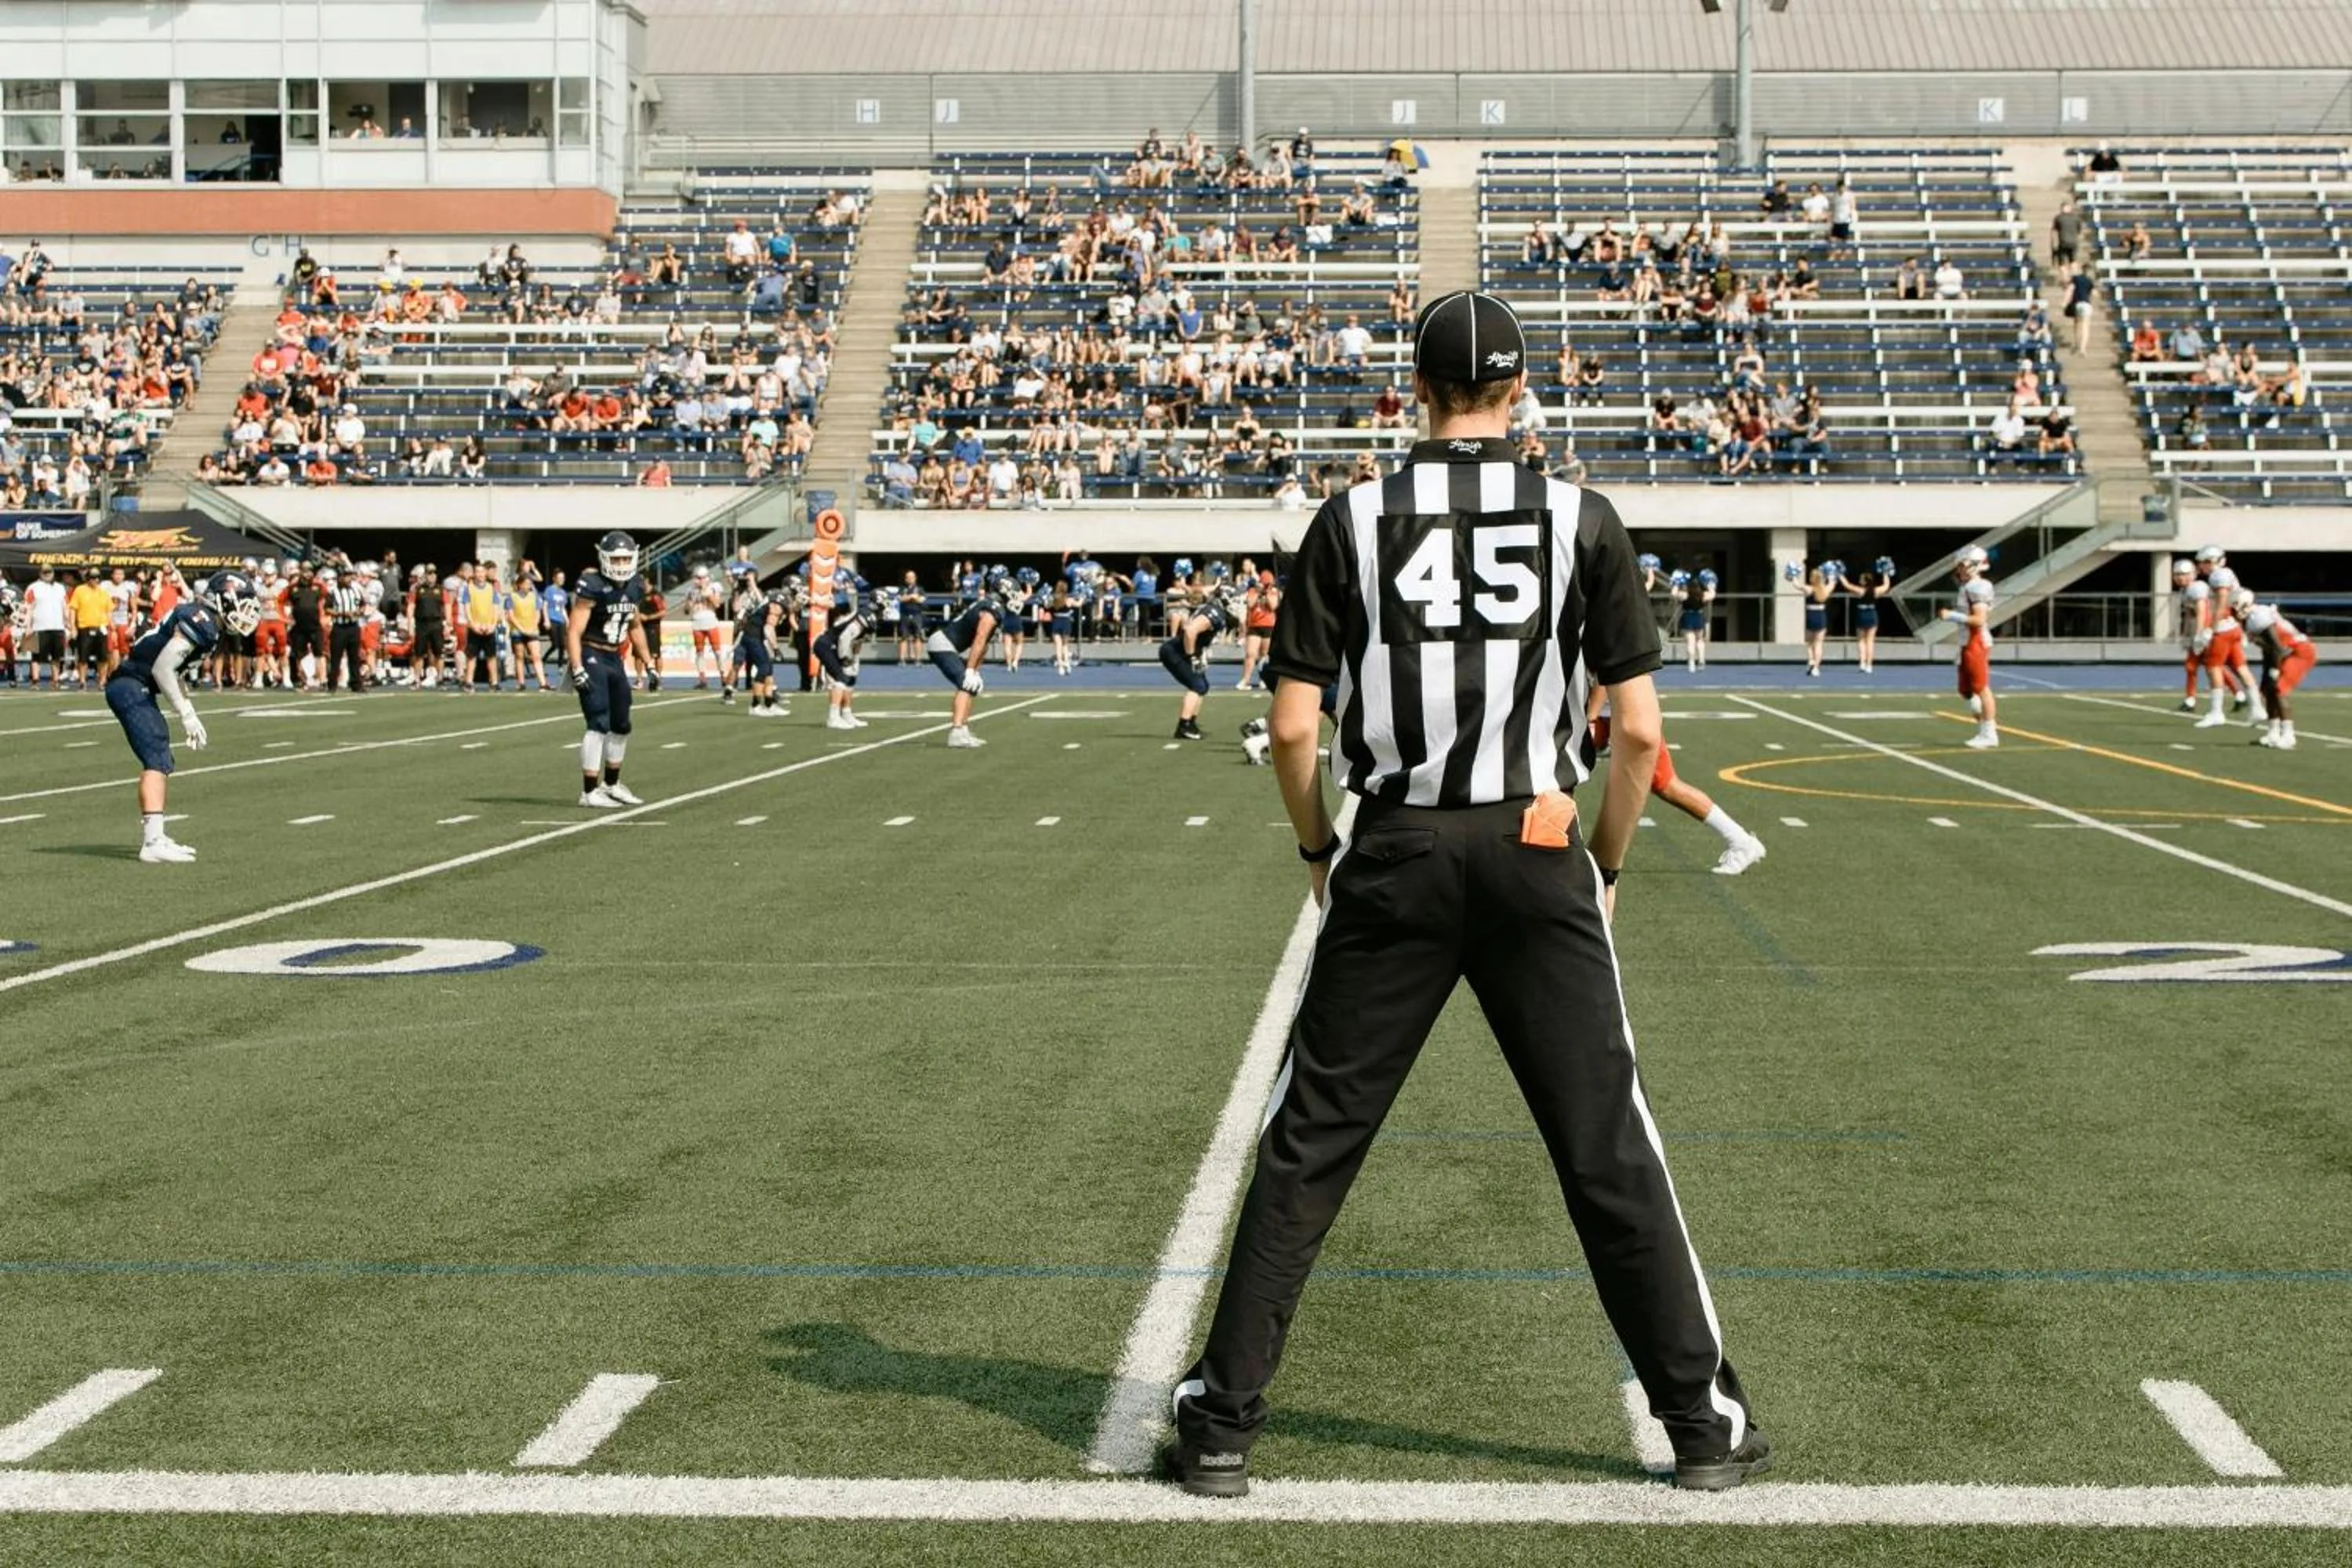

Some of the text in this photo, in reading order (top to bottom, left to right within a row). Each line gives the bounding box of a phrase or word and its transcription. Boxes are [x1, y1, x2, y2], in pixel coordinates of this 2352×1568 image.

[252, 234, 302, 257] G H
[1394, 524, 1541, 627] 45
[2028, 942, 2352, 982] 2
